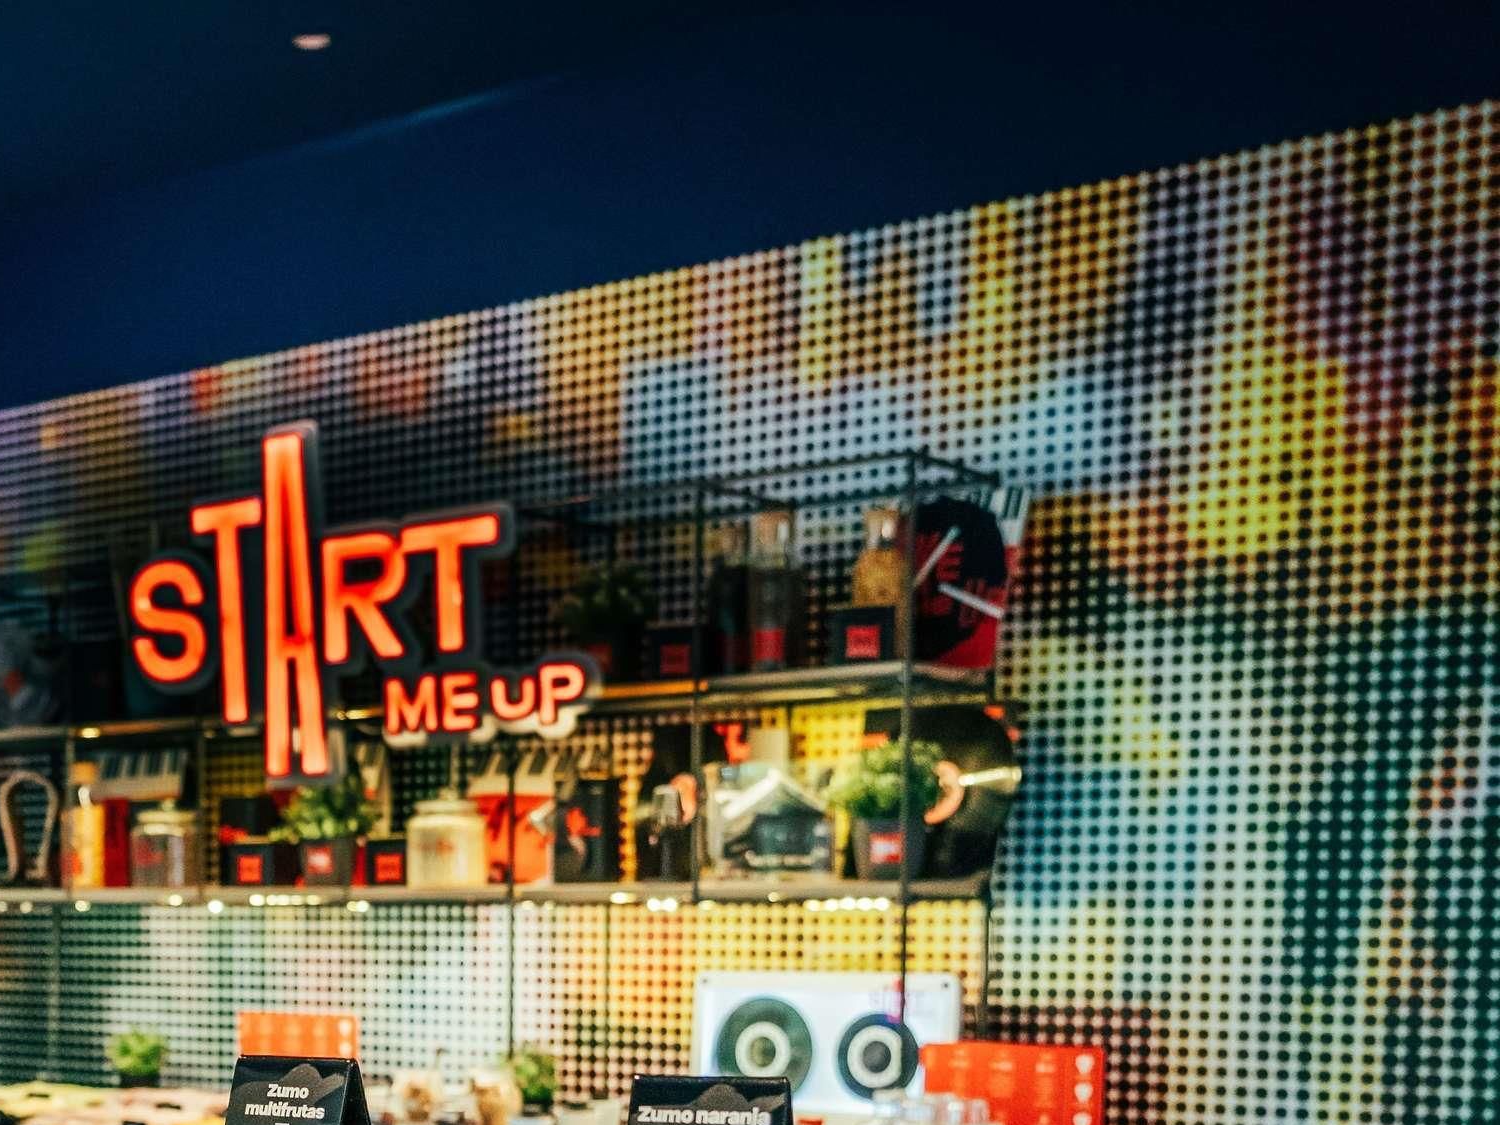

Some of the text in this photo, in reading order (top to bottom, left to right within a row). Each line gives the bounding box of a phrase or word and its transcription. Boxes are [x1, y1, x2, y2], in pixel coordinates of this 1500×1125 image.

[129, 431, 499, 776] START
[384, 663, 586, 736] ME UP
[266, 1083, 310, 1100] Zumo
[244, 1100, 326, 1120] multifrutas
[636, 1105, 695, 1124] Zumo
